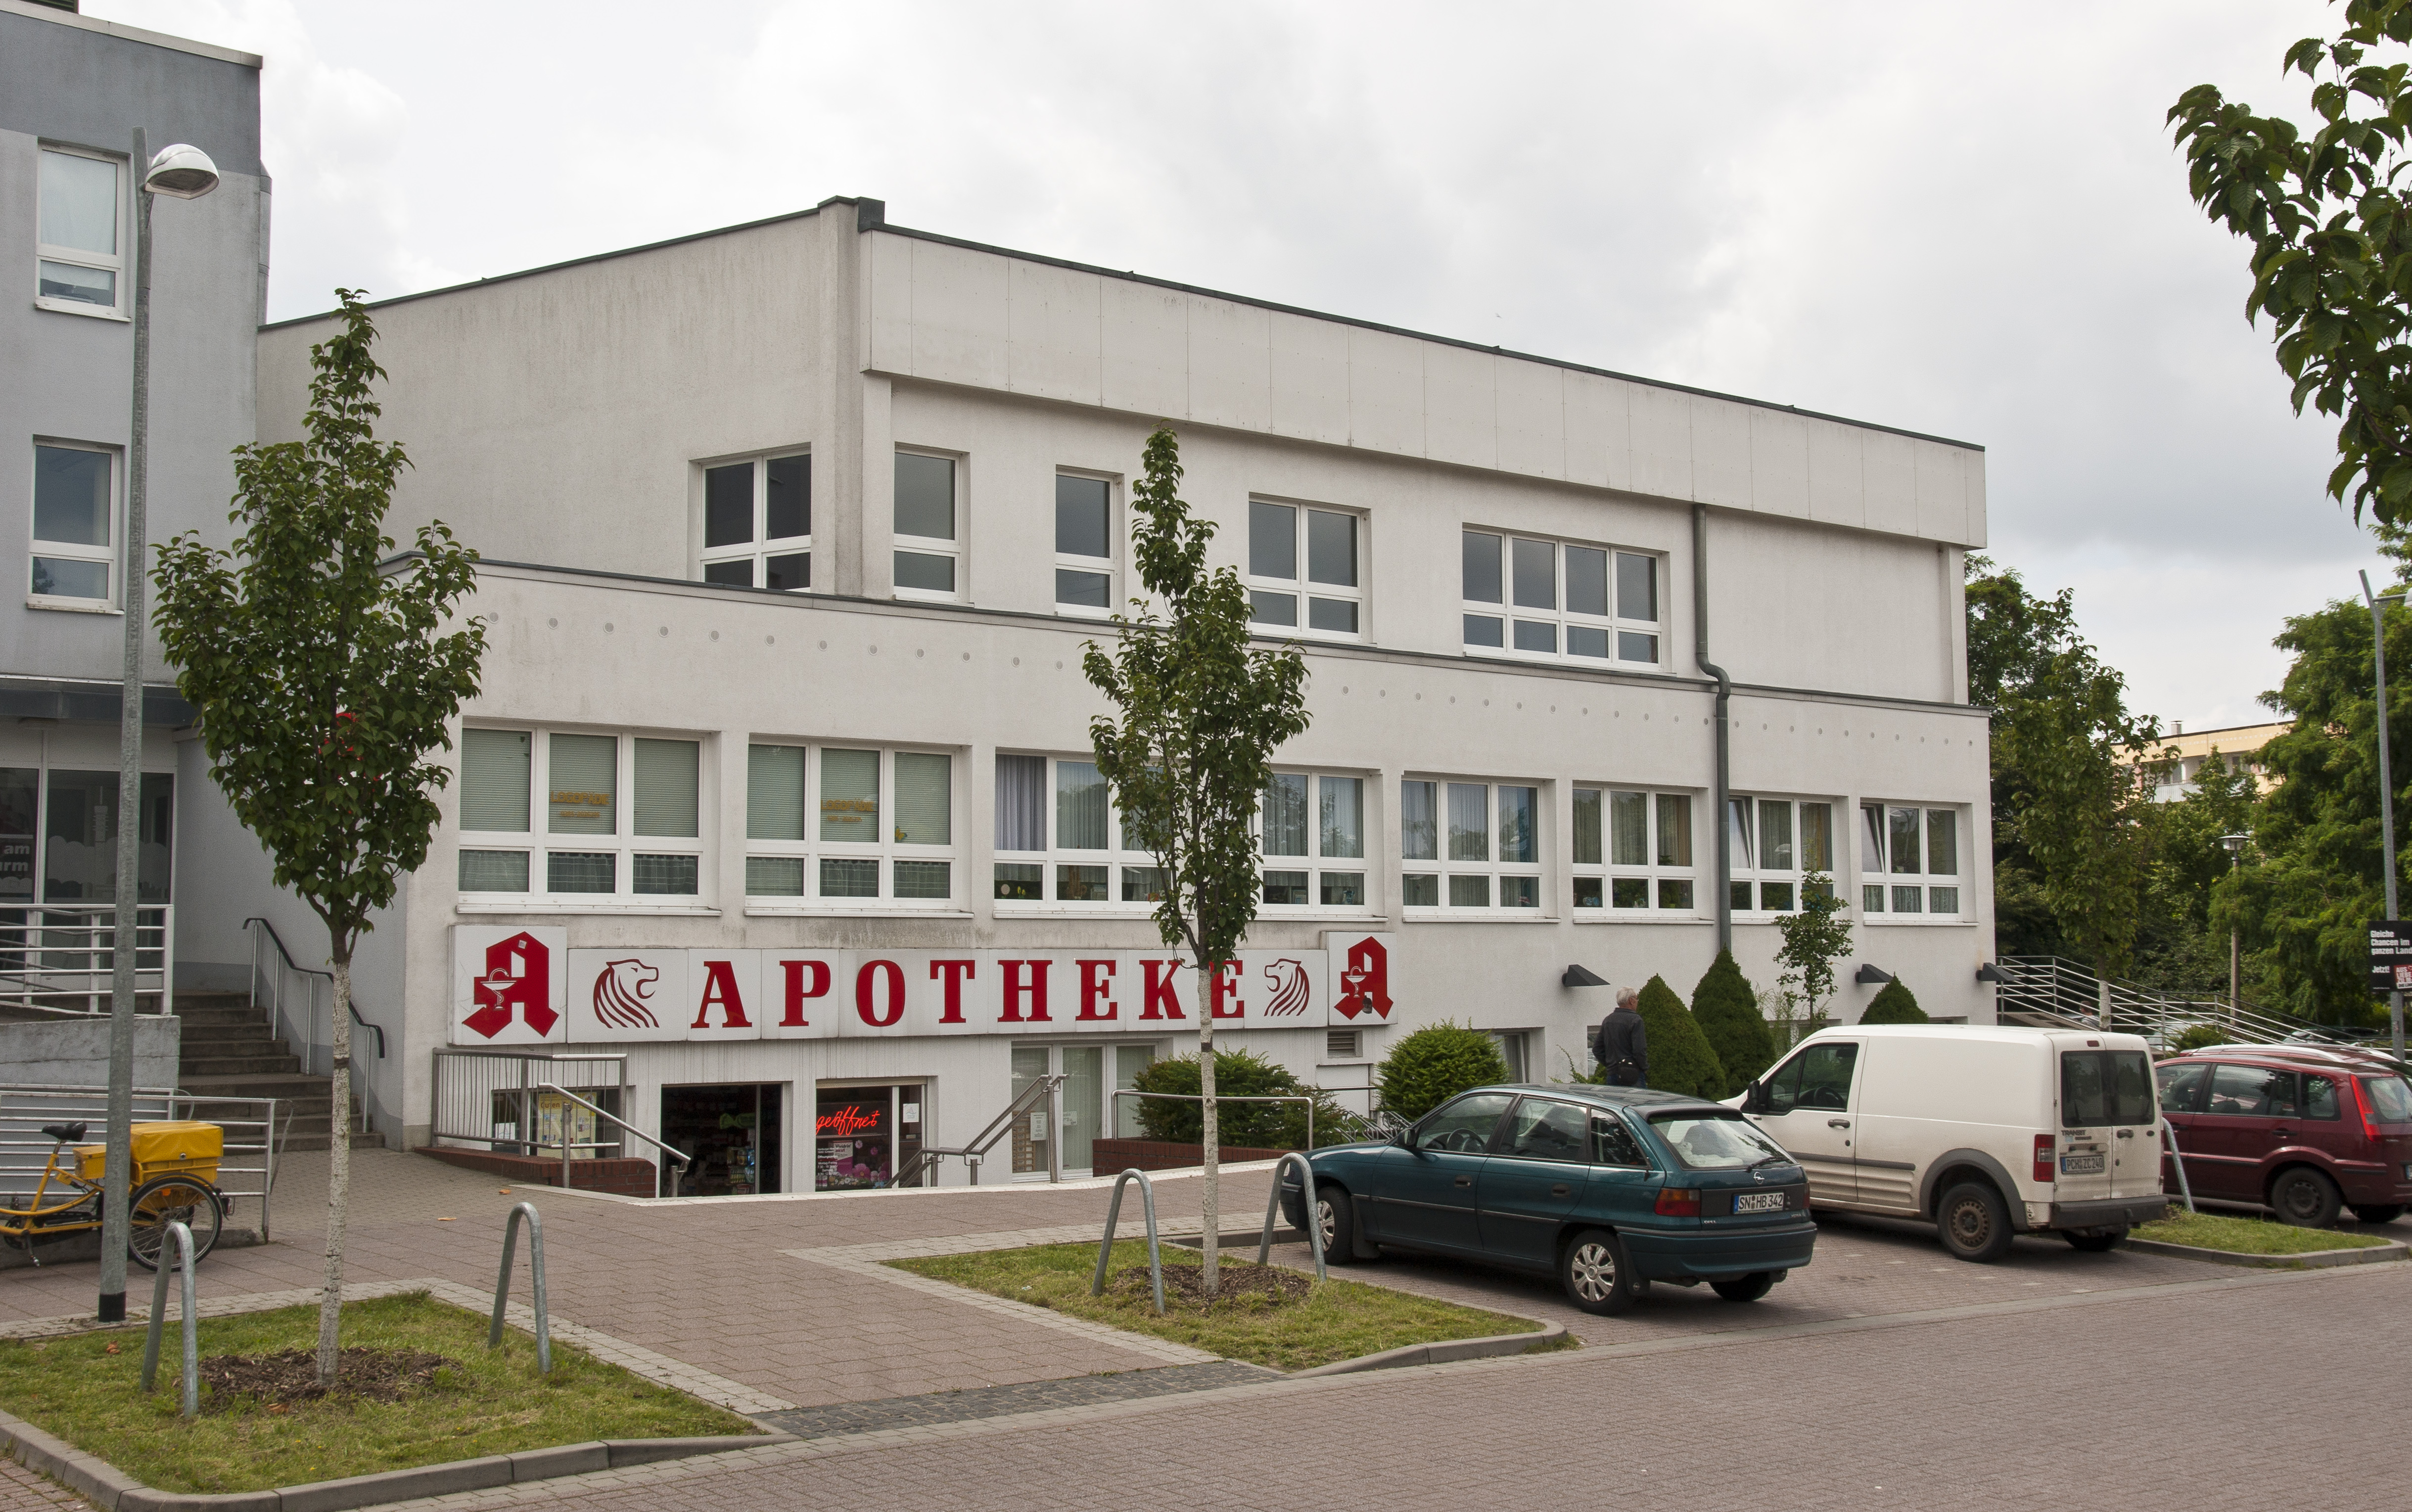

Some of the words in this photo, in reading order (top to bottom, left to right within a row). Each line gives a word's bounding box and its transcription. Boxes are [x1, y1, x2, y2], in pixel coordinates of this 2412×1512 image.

[551, 791, 609, 805] LOGOPÄDIE
[821, 798, 874, 811] LOGOPÄDIE
[4, 845, 30, 855] am
[691, 959, 1245, 1028] APOTHEKE
[815, 1105, 880, 1135] geöffnet
[2067, 1159, 2079, 1170] PCH
[1739, 1197, 1751, 1210] SN
[1756, 1195, 1767, 1208] HB
[1768, 1194, 1783, 1207] 342
